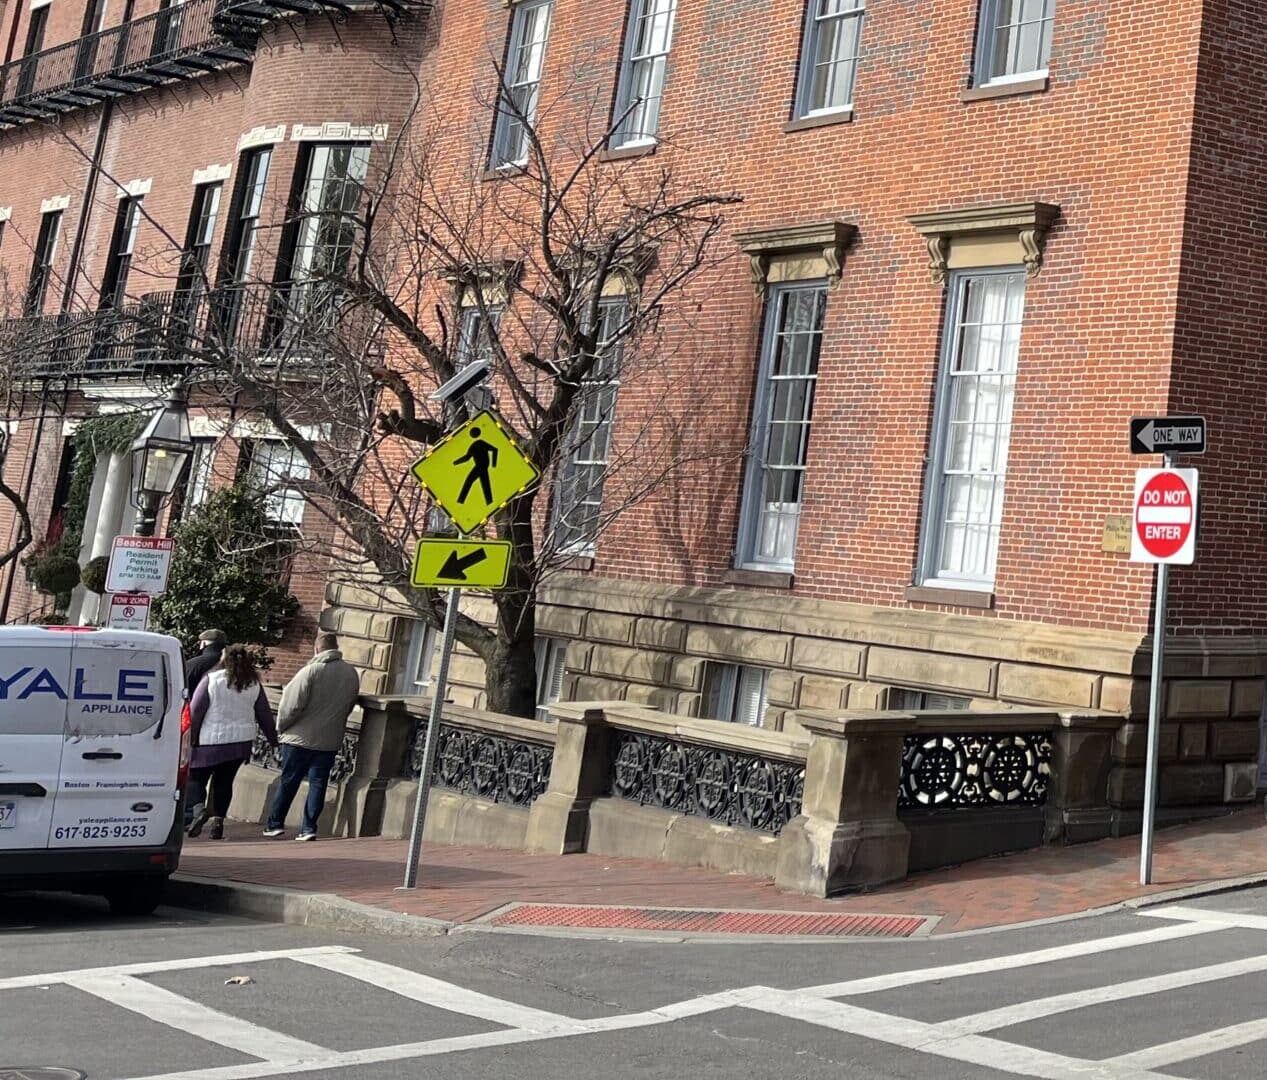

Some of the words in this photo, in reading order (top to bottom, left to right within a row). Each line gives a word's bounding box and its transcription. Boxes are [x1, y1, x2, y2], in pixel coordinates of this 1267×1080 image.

[1153, 429, 1173, 442] ONE
[1178, 429, 1198, 441] WAY
[1143, 490, 1160, 504] DO
[1164, 490, 1187, 504] NOT
[1145, 526, 1181, 539] ENTER
[116, 538, 153, 548] Beacon
[157, 540, 171, 549] Hill
[126, 550, 164, 560] Resident
[129, 558, 157, 566] Permit
[126, 565, 158, 574] Parking
[129, 597, 148, 605] ZONE
[0, 667, 155, 701] YALE
[81, 704, 153, 715] APPLIANCE
[79, 816, 148, 824] yaleappliance.com
